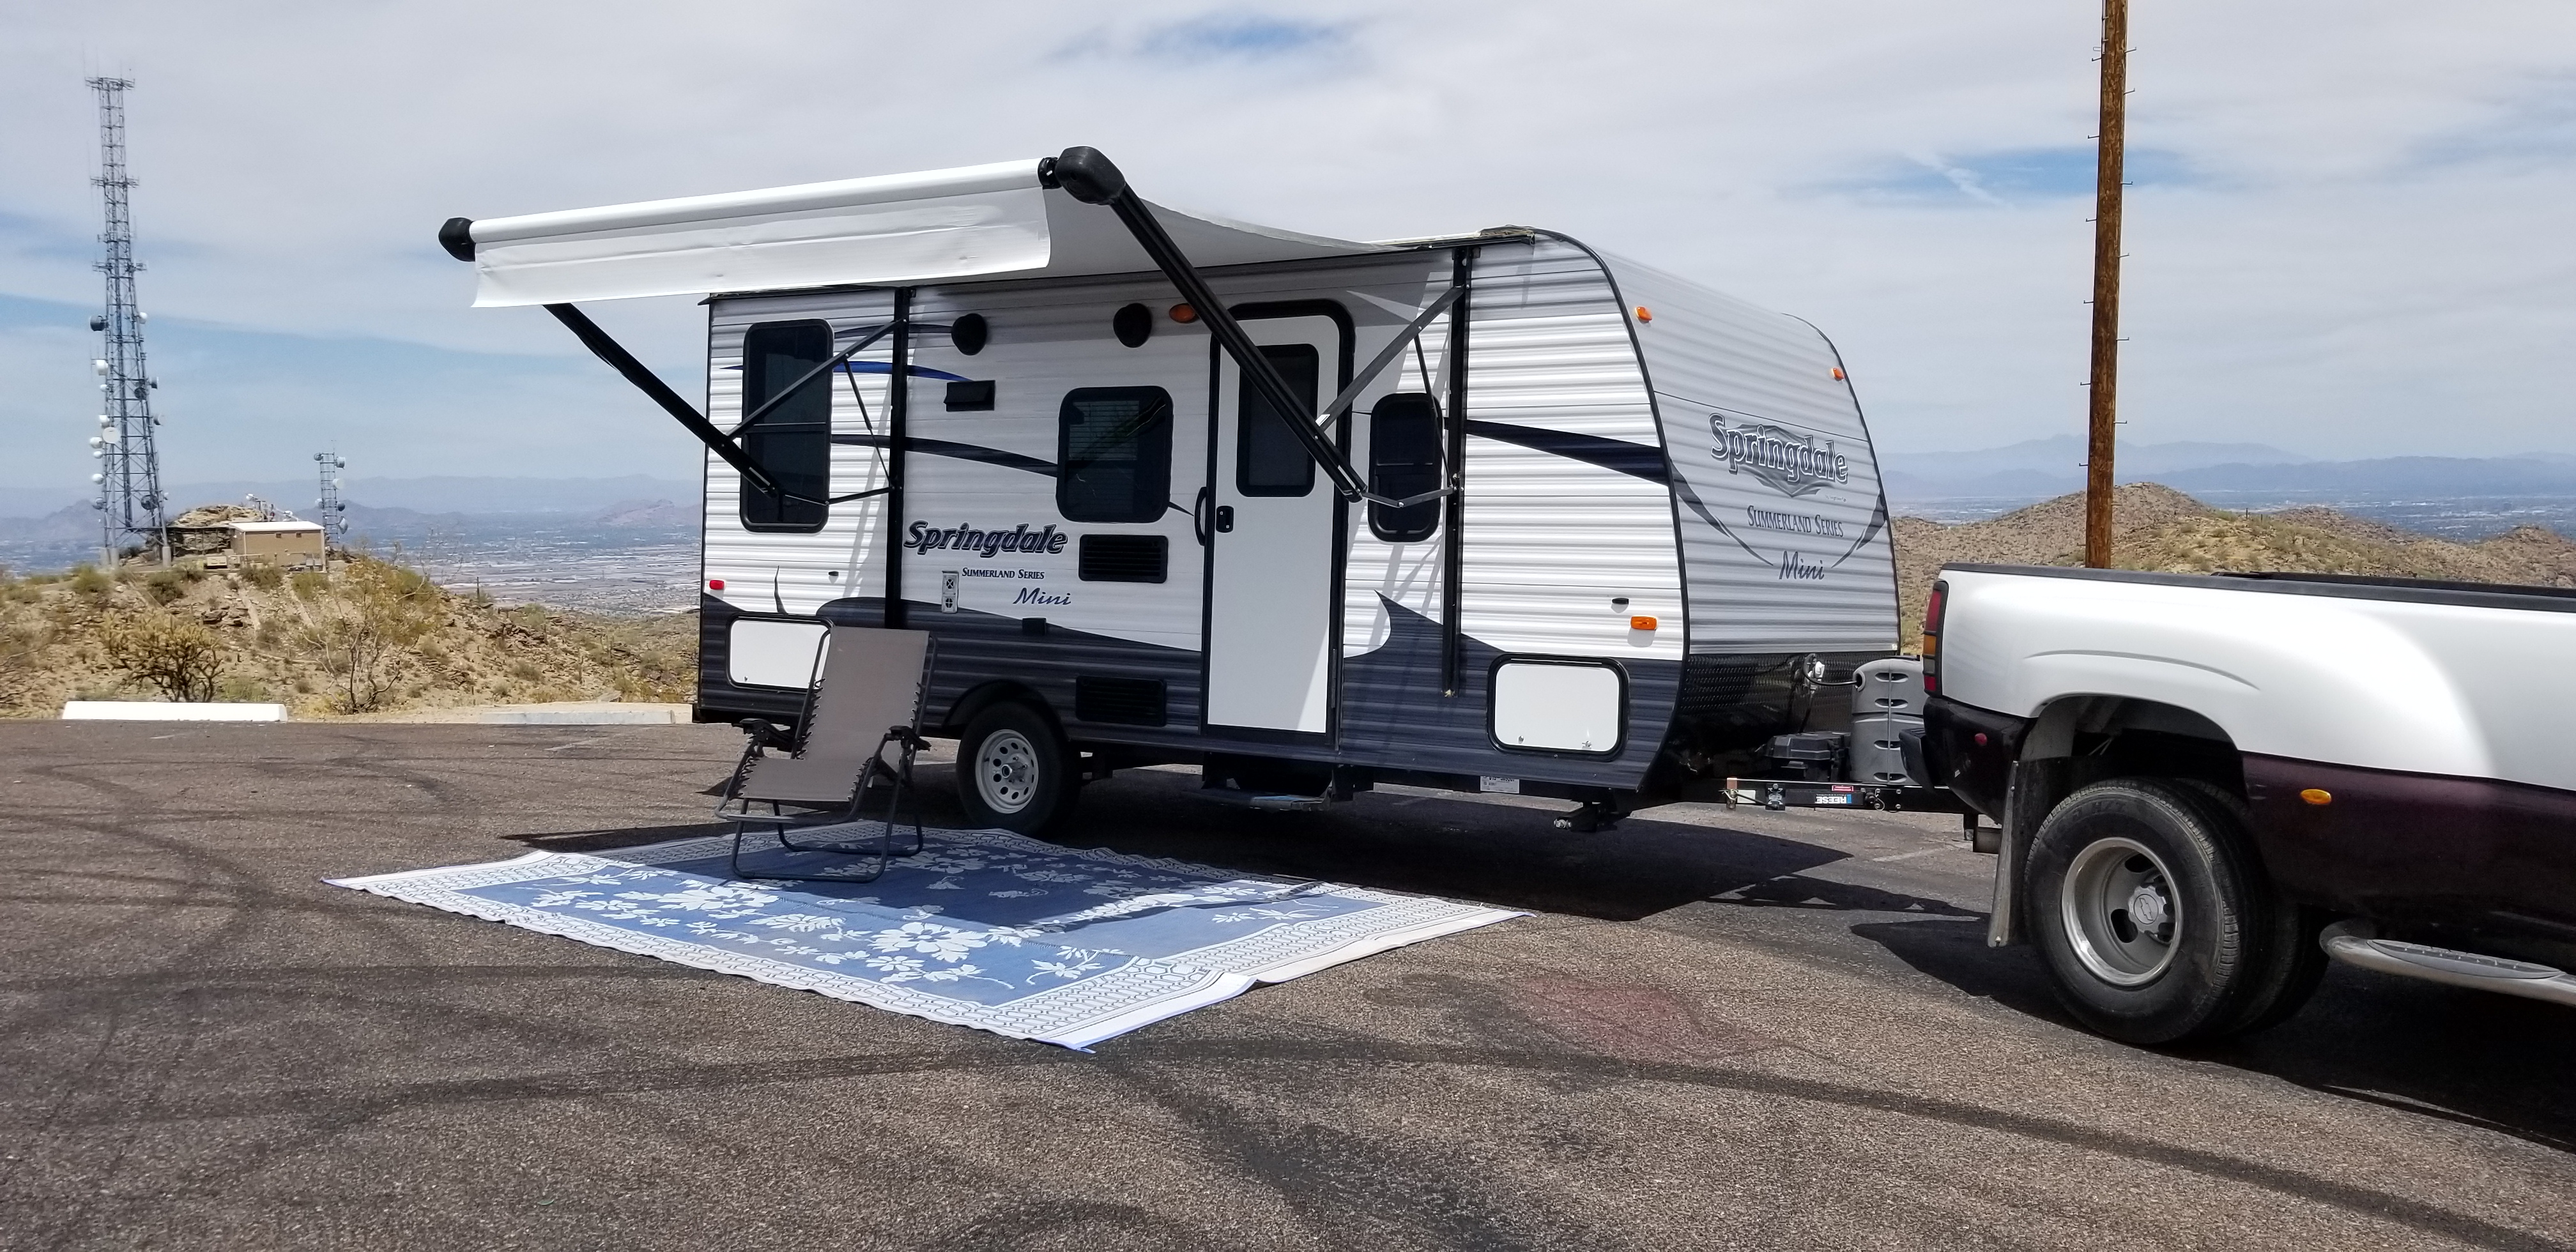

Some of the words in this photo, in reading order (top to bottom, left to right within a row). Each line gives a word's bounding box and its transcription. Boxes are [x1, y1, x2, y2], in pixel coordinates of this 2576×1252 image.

[1708, 413, 1849, 484] Springdale
[1747, 505, 1811, 533] SUMMERLAND
[1815, 514, 1844, 538] SERIES
[903, 520, 1068, 558] Springdale
[962, 567, 1015, 579] SUMMERLAND
[1018, 569, 1045, 579] SERIES
[1779, 551, 1825, 580] Mini
[1013, 588, 1071, 605] Mini
[1816, 796, 1847, 804] REESE
